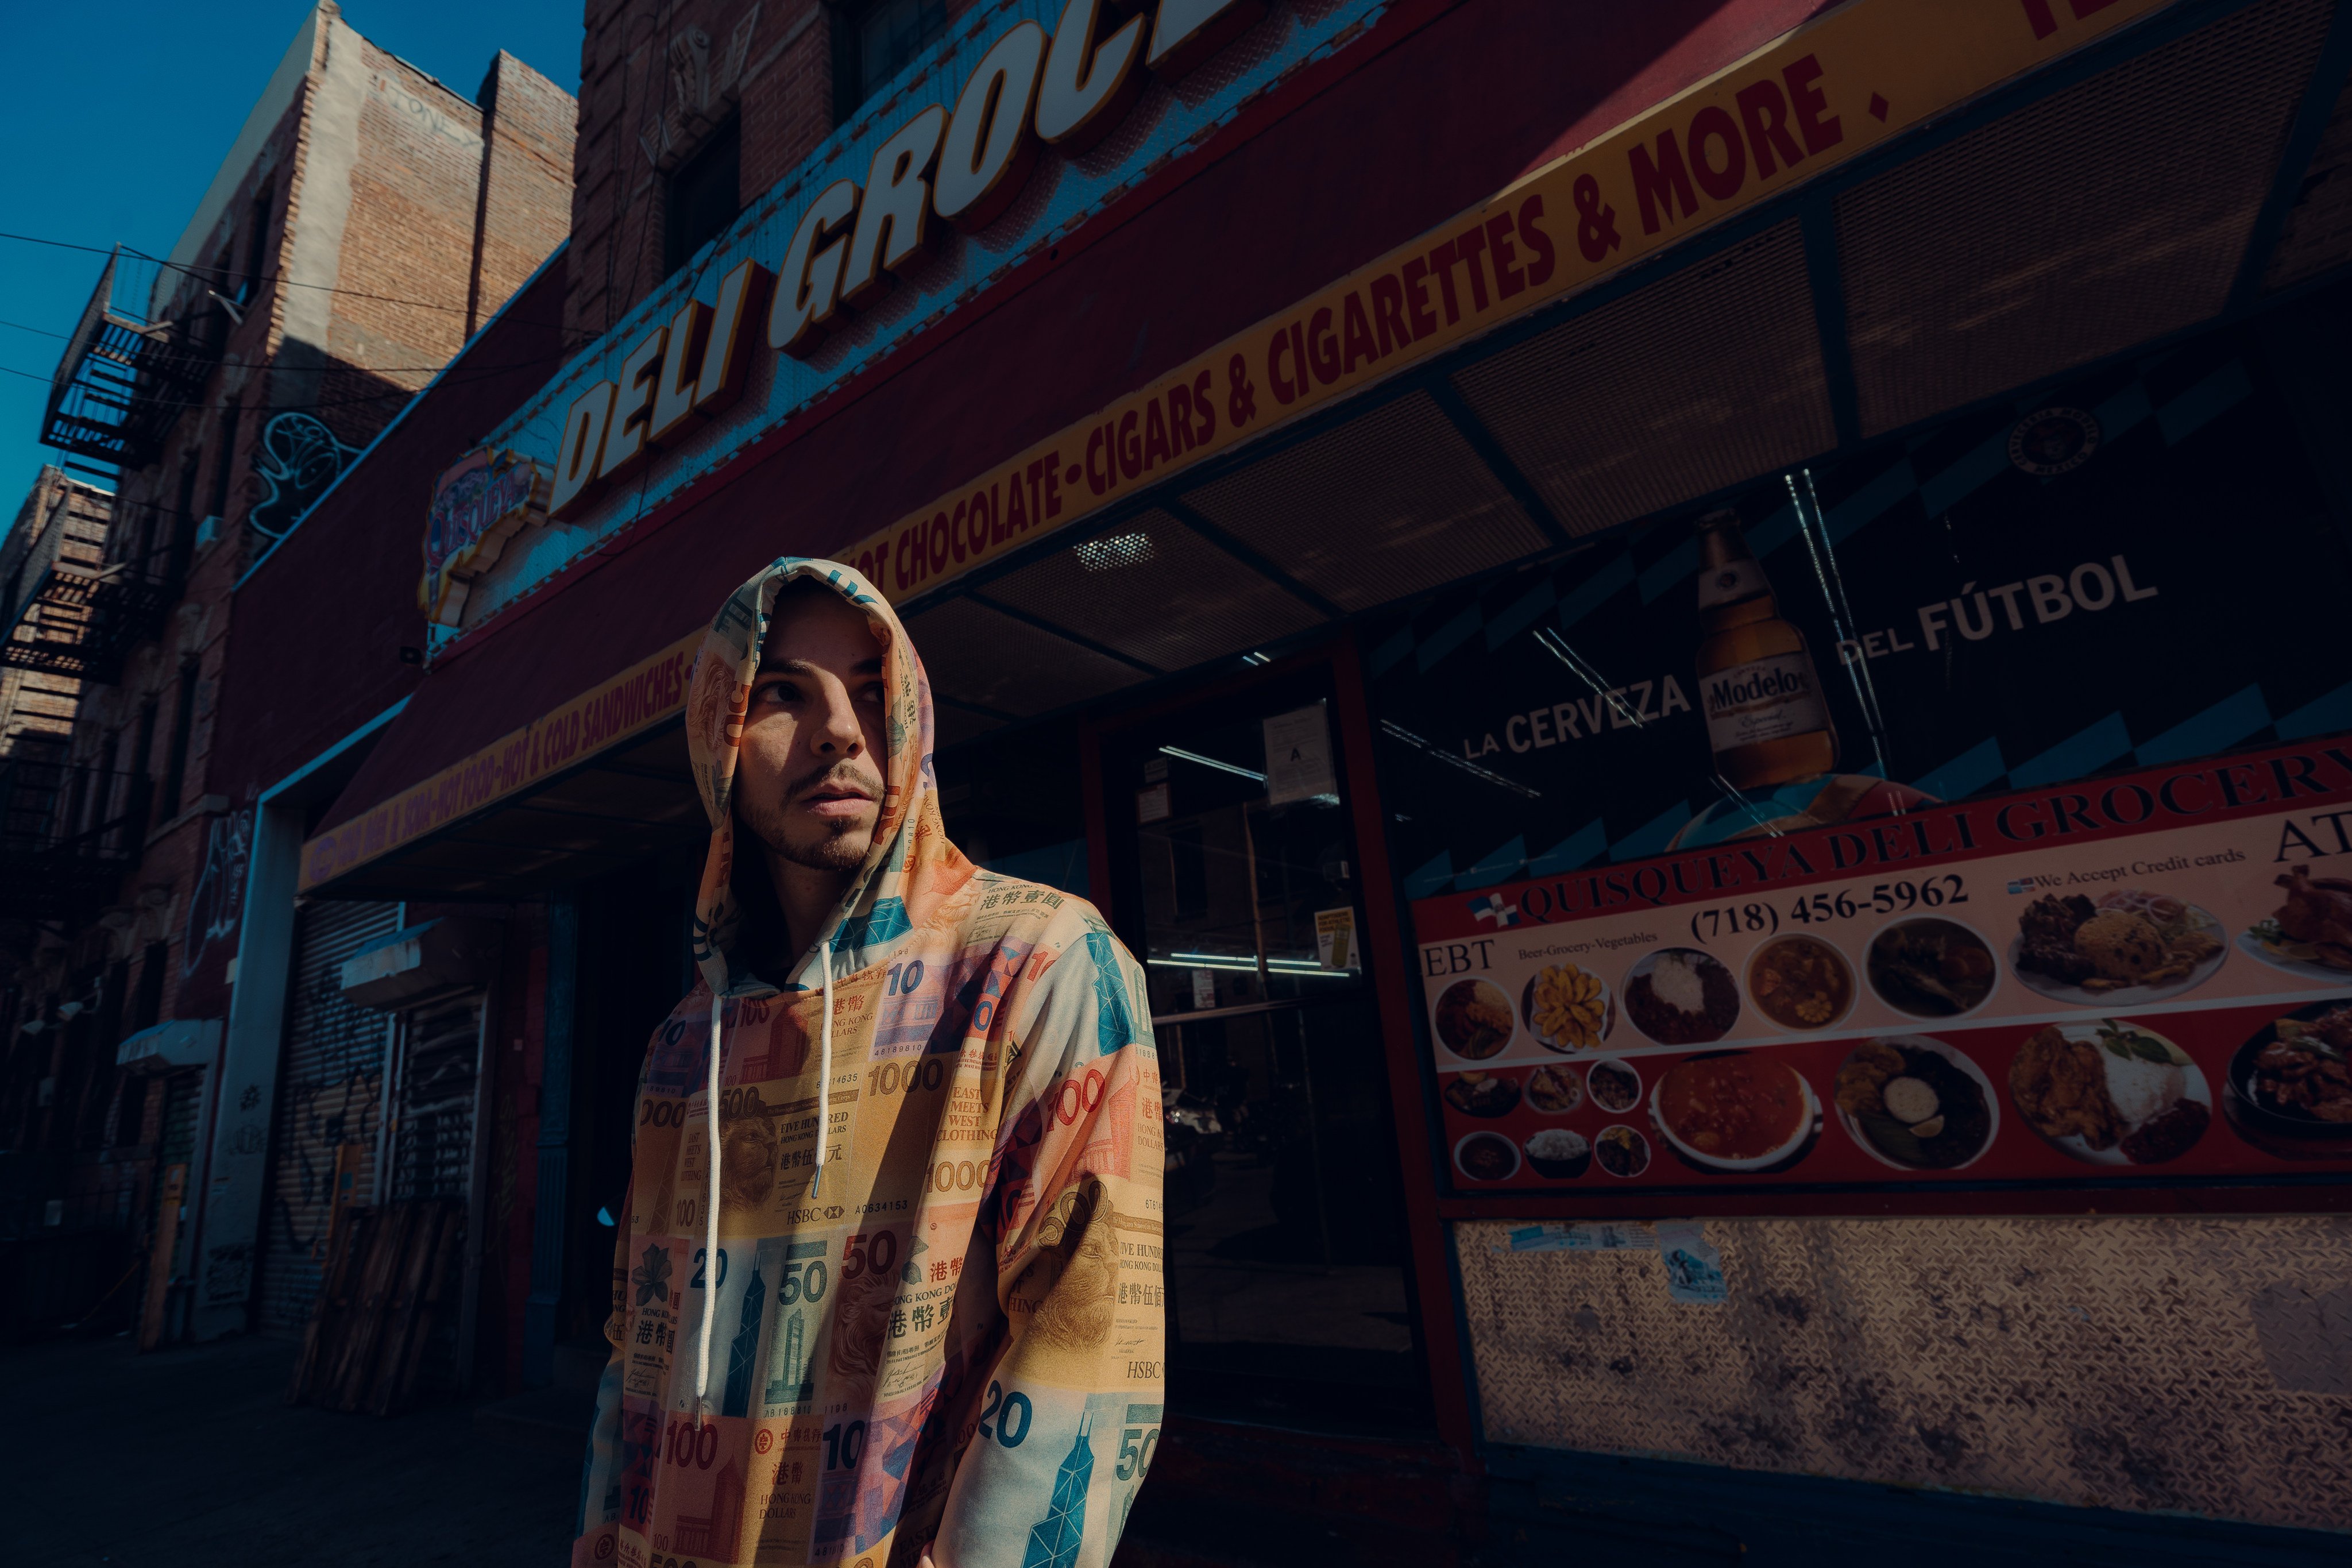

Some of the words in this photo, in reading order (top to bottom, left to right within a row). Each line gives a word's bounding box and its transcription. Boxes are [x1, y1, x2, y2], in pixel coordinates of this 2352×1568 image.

[549, 257, 755, 519] DELI
[461, 754, 495, 811] FOOD
[500, 735, 530, 791] HOT
[530, 731, 540, 776] &
[543, 709, 580, 770] COLD
[582, 651, 683, 751] SANDWICHES
[895, 450, 1063, 591] CHOCOLATE
[1085, 393, 1216, 496] CIGARS
[1227, 352, 1257, 427] &
[1267, 194, 1556, 405] CIGARETTES
[1572, 172, 1622, 263] &
[1628, 53, 1843, 236] MORE
[1834, 628, 1915, 667] DEL
[1917, 554, 2160, 652] FÚTBOL
[1712, 666, 1798, 710] Modelo
[1462, 733, 1501, 762] LA
[1503, 674, 1692, 755] CERVEZA
[2273, 810, 2352, 863] AT
[1520, 841, 1817, 923] QUISQUEYA
[1827, 811, 1982, 872] DELI
[2036, 871, 2063, 889] We
[2067, 862, 2129, 886] Accept
[2131, 855, 2191, 876] Credit
[2195, 848, 2246, 867] cards
[1691, 902, 1779, 945] (718)
[1790, 874, 1969, 925] 456-5962
[1420, 939, 1496, 978] EBT
[1517, 930, 1659, 961] Beer-Grocery-Vegetables
[887, 960, 925, 996] 10
[848, 1013, 873, 1024] KONG
[818, 1026, 858, 1041] LLARS
[874, 1044, 922, 1056] 48189810
[725, 1075, 737, 1087] 100
[868, 1058, 944, 1096] 1000
[719, 1086, 760, 1119] 500
[953, 1086, 983, 1100] EAST
[951, 1100, 989, 1114] MEETS
[781, 1121, 799, 1134] FIVE
[801, 1111, 849, 1130] HUNRED
[948, 1115, 982, 1127] WEST
[1137, 1123, 1156, 1136] HONG
[781, 1135, 797, 1144] HONG
[797, 1130, 813, 1141] KONG
[936, 1129, 998, 1142] CLOTHING
[1137, 1136, 1164, 1152] DOLLARS
[780, 1144, 843, 1171] 港幣伍元
[787, 1207, 821, 1225] HSBC
[855, 1200, 909, 1215] A0634153
[1036, 1180, 1109, 1249] 500
[841, 1230, 897, 1280] 50
[1137, 1243, 1163, 1260] HUNDRE
[690, 1248, 728, 1290] 20
[1134, 1260, 1152, 1272] KONG
[779, 1261, 828, 1306] 50
[915, 1288, 943, 1302] KONG
[642, 1307, 661, 1318] HONG
[1127, 1361, 1161, 1380] HSBC
[978, 1380, 1032, 1449] 20
[666, 1422, 717, 1470] 100
[821, 1419, 866, 1471] 10
[1117, 1429, 1160, 1481] 50
[760, 1493, 789, 1505] HONG
[791, 1493, 811, 1505] KONG
[759, 1508, 797, 1520] DOLLARS
[654, 1533, 669, 1551] 100
